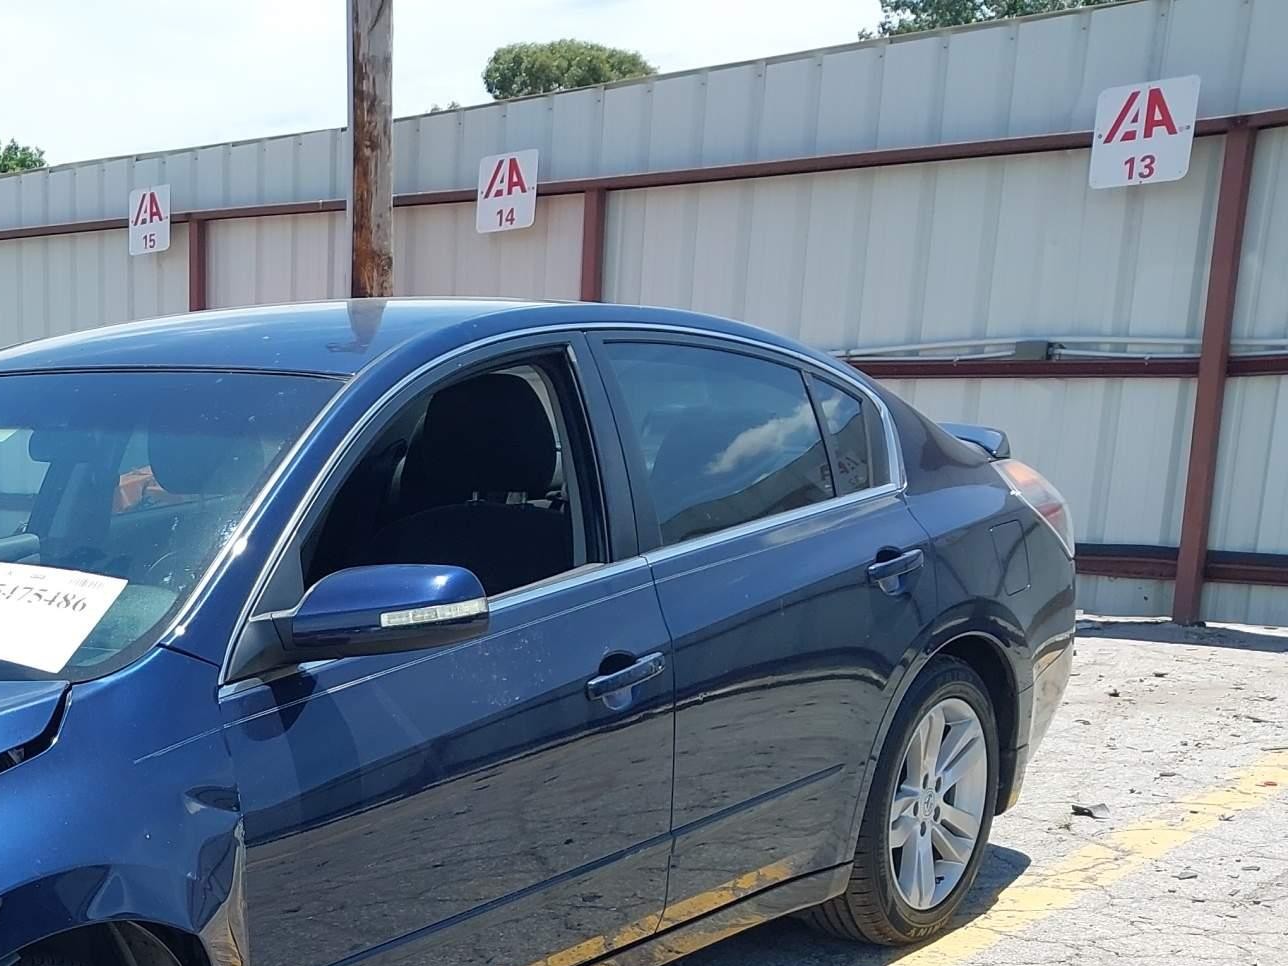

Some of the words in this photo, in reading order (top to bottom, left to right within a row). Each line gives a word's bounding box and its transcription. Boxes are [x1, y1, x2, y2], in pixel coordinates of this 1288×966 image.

[1124, 154, 1156, 180] 13
[496, 207, 515, 227] 14
[143, 233, 156, 249] 15
